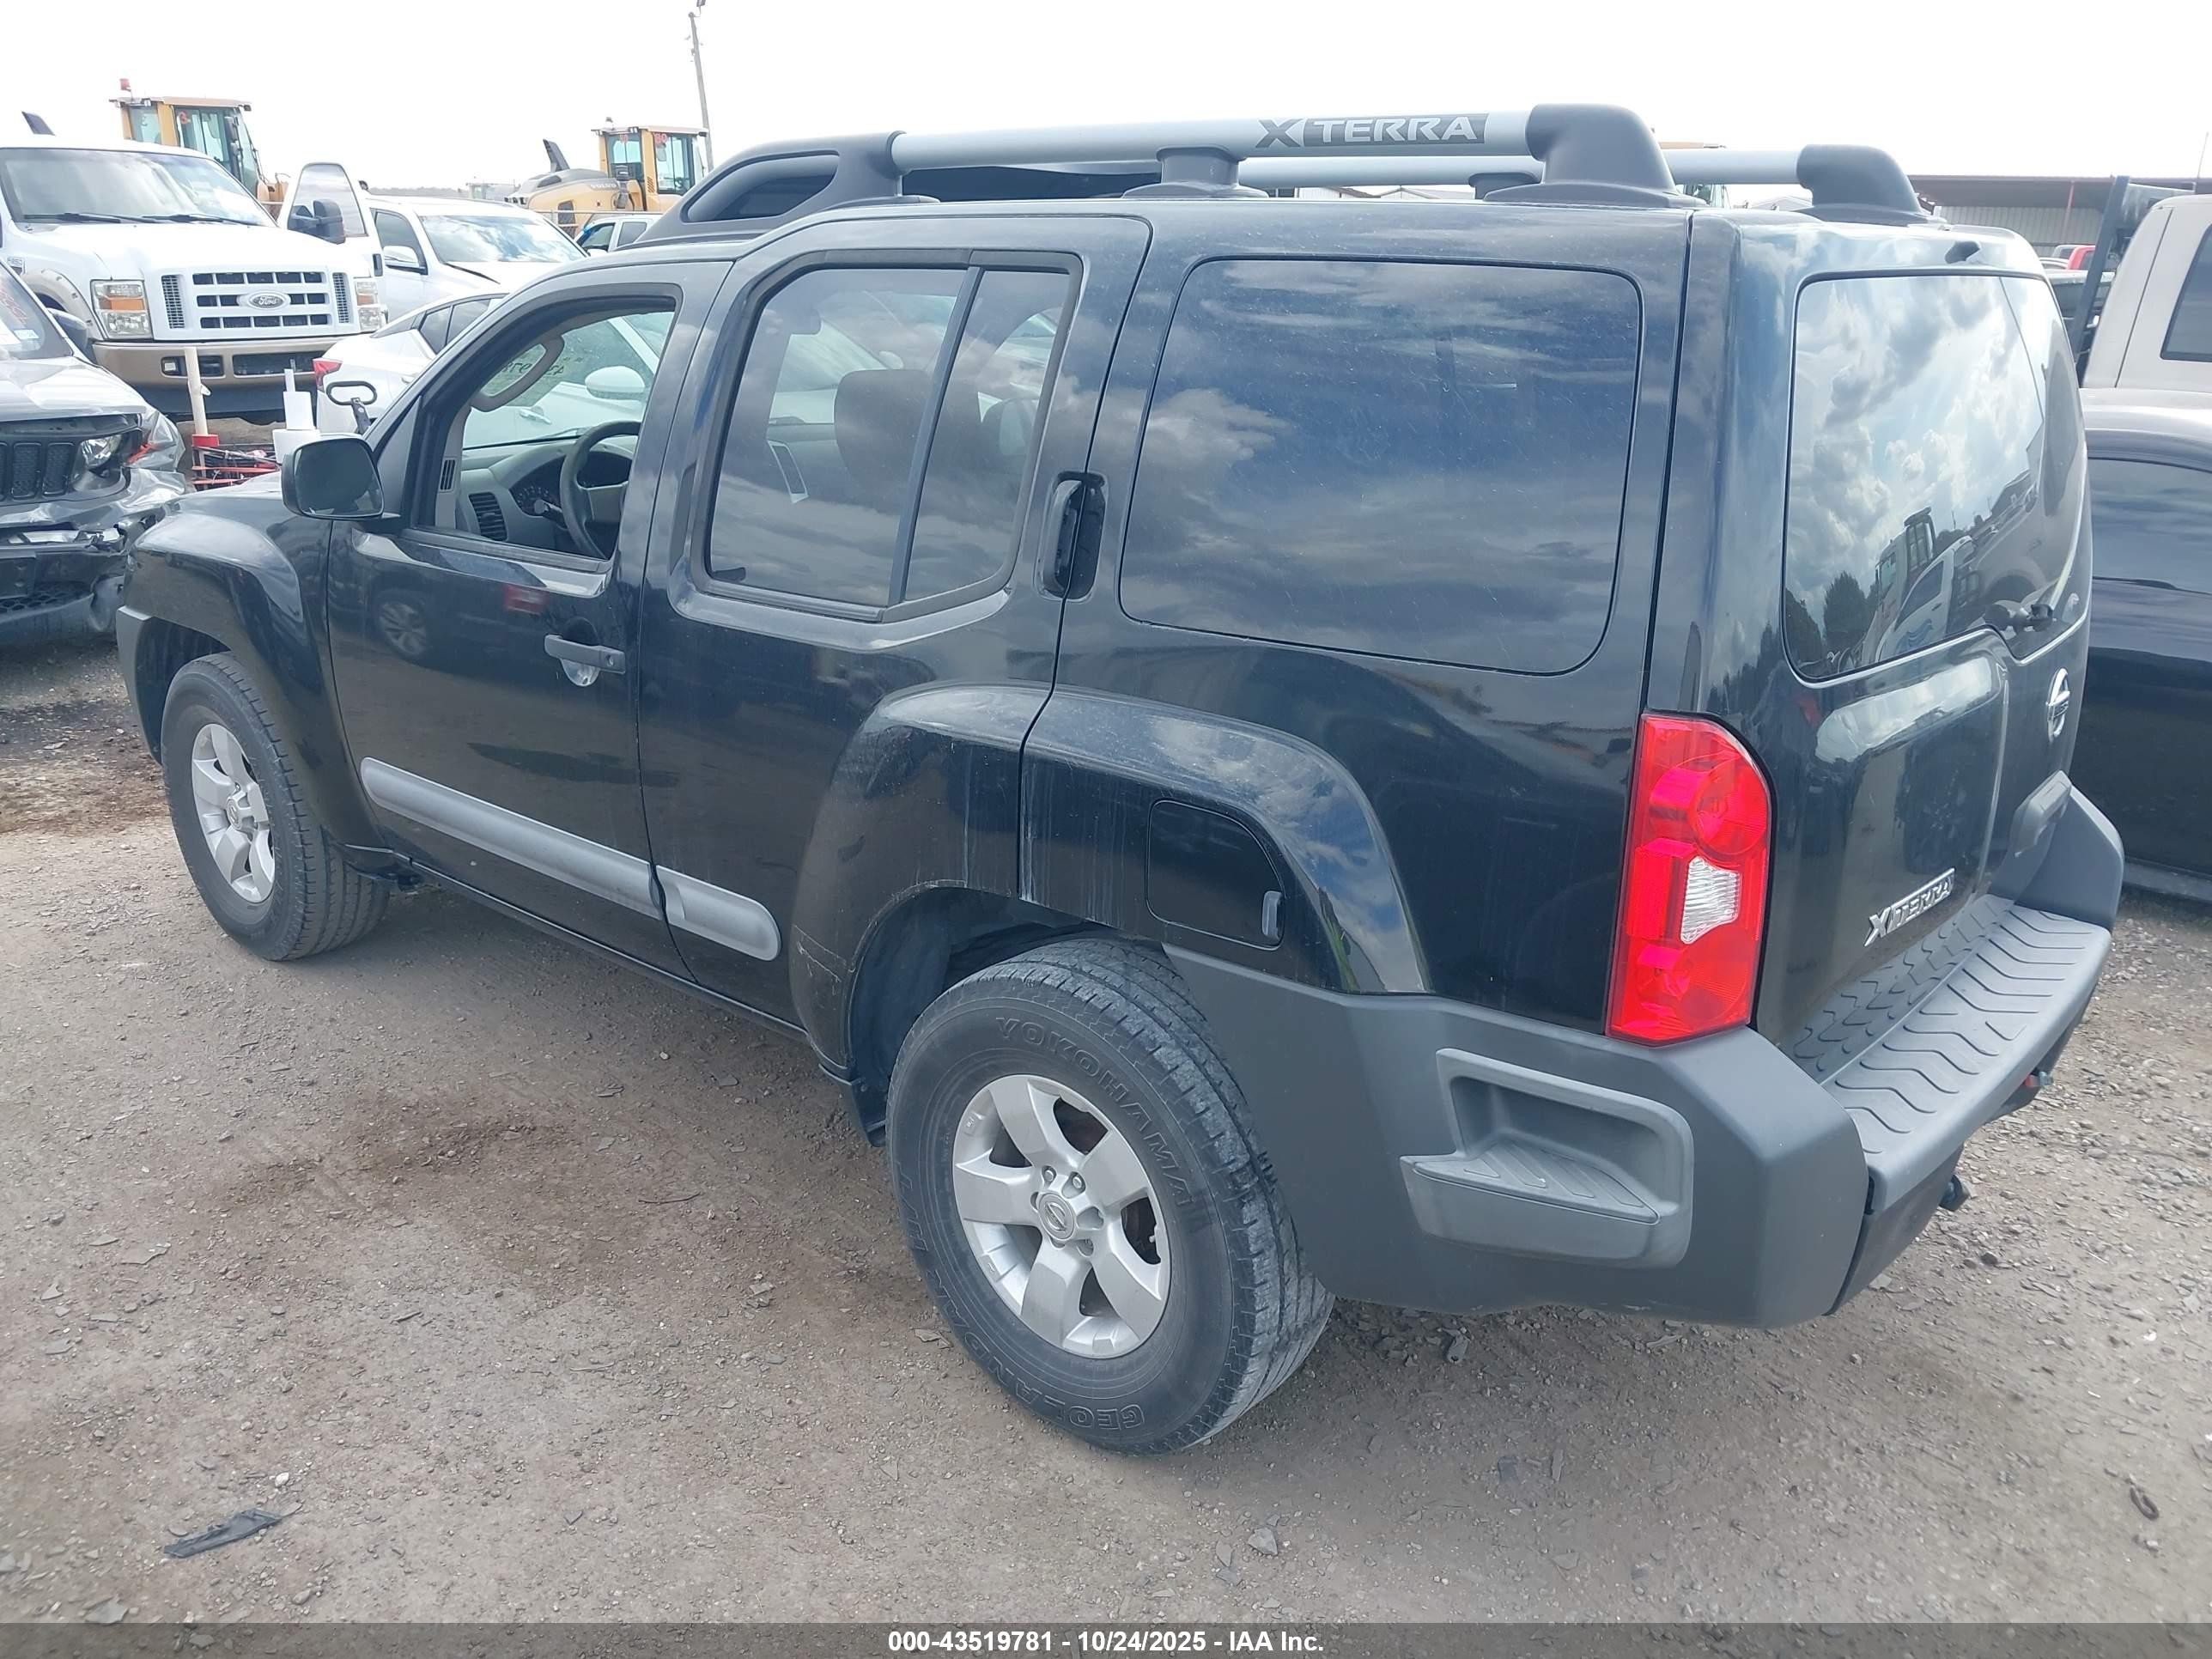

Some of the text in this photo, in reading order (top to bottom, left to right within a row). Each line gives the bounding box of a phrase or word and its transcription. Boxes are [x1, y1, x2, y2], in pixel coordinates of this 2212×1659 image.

[259, 295, 278, 305] Ford
[1864, 869, 1954, 946] XTERRA
[995, 1017, 1195, 1206] YOKOHAMA
